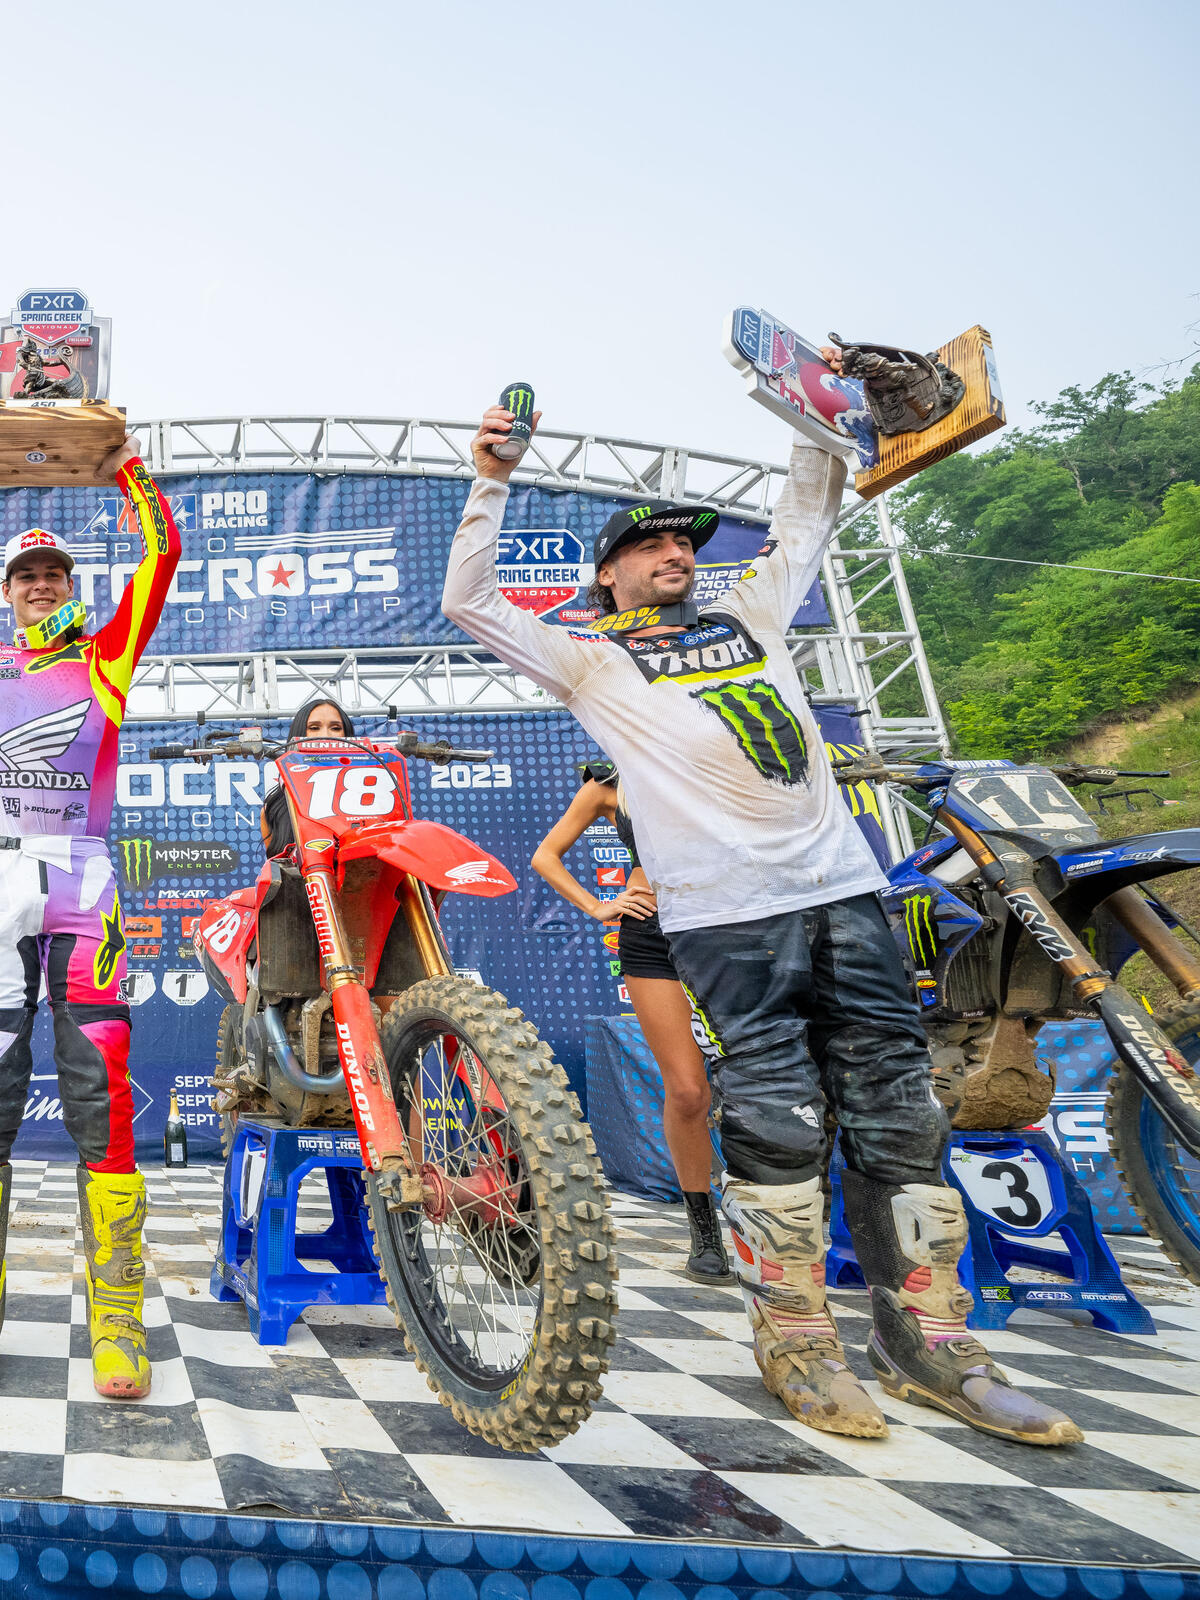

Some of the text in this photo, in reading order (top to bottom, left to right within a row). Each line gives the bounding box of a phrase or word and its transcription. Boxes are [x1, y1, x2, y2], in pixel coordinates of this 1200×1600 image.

[31, 296, 75, 309] FXR
[21, 313, 82, 322] SPRING CREEK
[743, 313, 758, 351] FXR
[202, 490, 267, 516] PRO
[133, 465, 168, 555] alpinestars
[202, 513, 268, 529] RACING
[652, 515, 694, 526] YAMAHA
[20, 538, 57, 550] Red Bull
[496, 537, 565, 560] FXR
[497, 569, 580, 583] RING CREEK
[694, 569, 747, 580] SUPE
[696, 580, 738, 589] MOT
[693, 589, 733, 600] CRO
[562, 610, 596, 618] FRESCADOS
[638, 633, 755, 674] THOR
[0, 771, 90, 790] HONDA
[430, 764, 513, 788] 2023
[306, 767, 398, 820] 18
[585, 825, 619, 835] GEIC
[156, 848, 233, 861] MONSTER
[594, 847, 632, 862] WP
[1075, 859, 1104, 870] YAMAHA
[450, 876, 508, 887] HONDA
[158, 890, 210, 898] MX-ATV
[144, 898, 224, 911] LEGEN
[202, 908, 241, 954] 18
[133, 944, 161, 954] ETS
[1116, 1013, 1200, 1112] DUNLOP
[1122, 1041, 1161, 1083] BRAKING
[174, 1075, 213, 1087] SEPT
[336, 1022, 376, 1132] DUNLOP
[176, 1094, 214, 1107] SEPT
[981, 1161, 1042, 1227] 3
[1026, 1291, 1073, 1300] ACERBIS
[1081, 1292, 1127, 1302] MOTOCROSS
